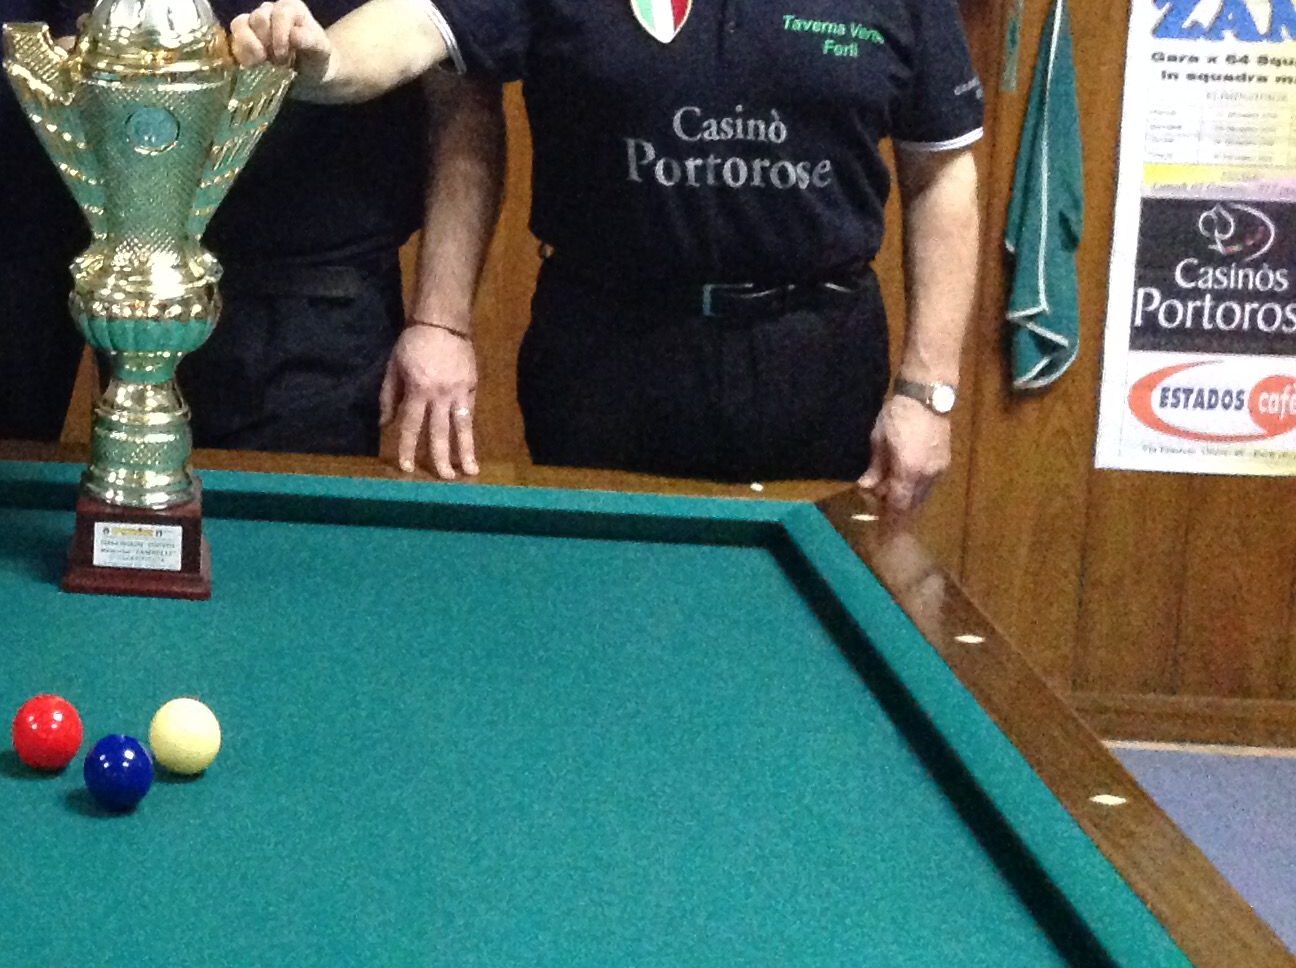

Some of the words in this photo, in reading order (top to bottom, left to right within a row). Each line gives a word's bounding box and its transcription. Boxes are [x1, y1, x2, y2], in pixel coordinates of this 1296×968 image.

[783, 14, 847, 36] Taverna
[1151, 51, 1200, 64] Gara
[672, 104, 788, 144] Casinò
[624, 137, 832, 190] Portorose
[1158, 386, 1246, 411] ESTADOS
